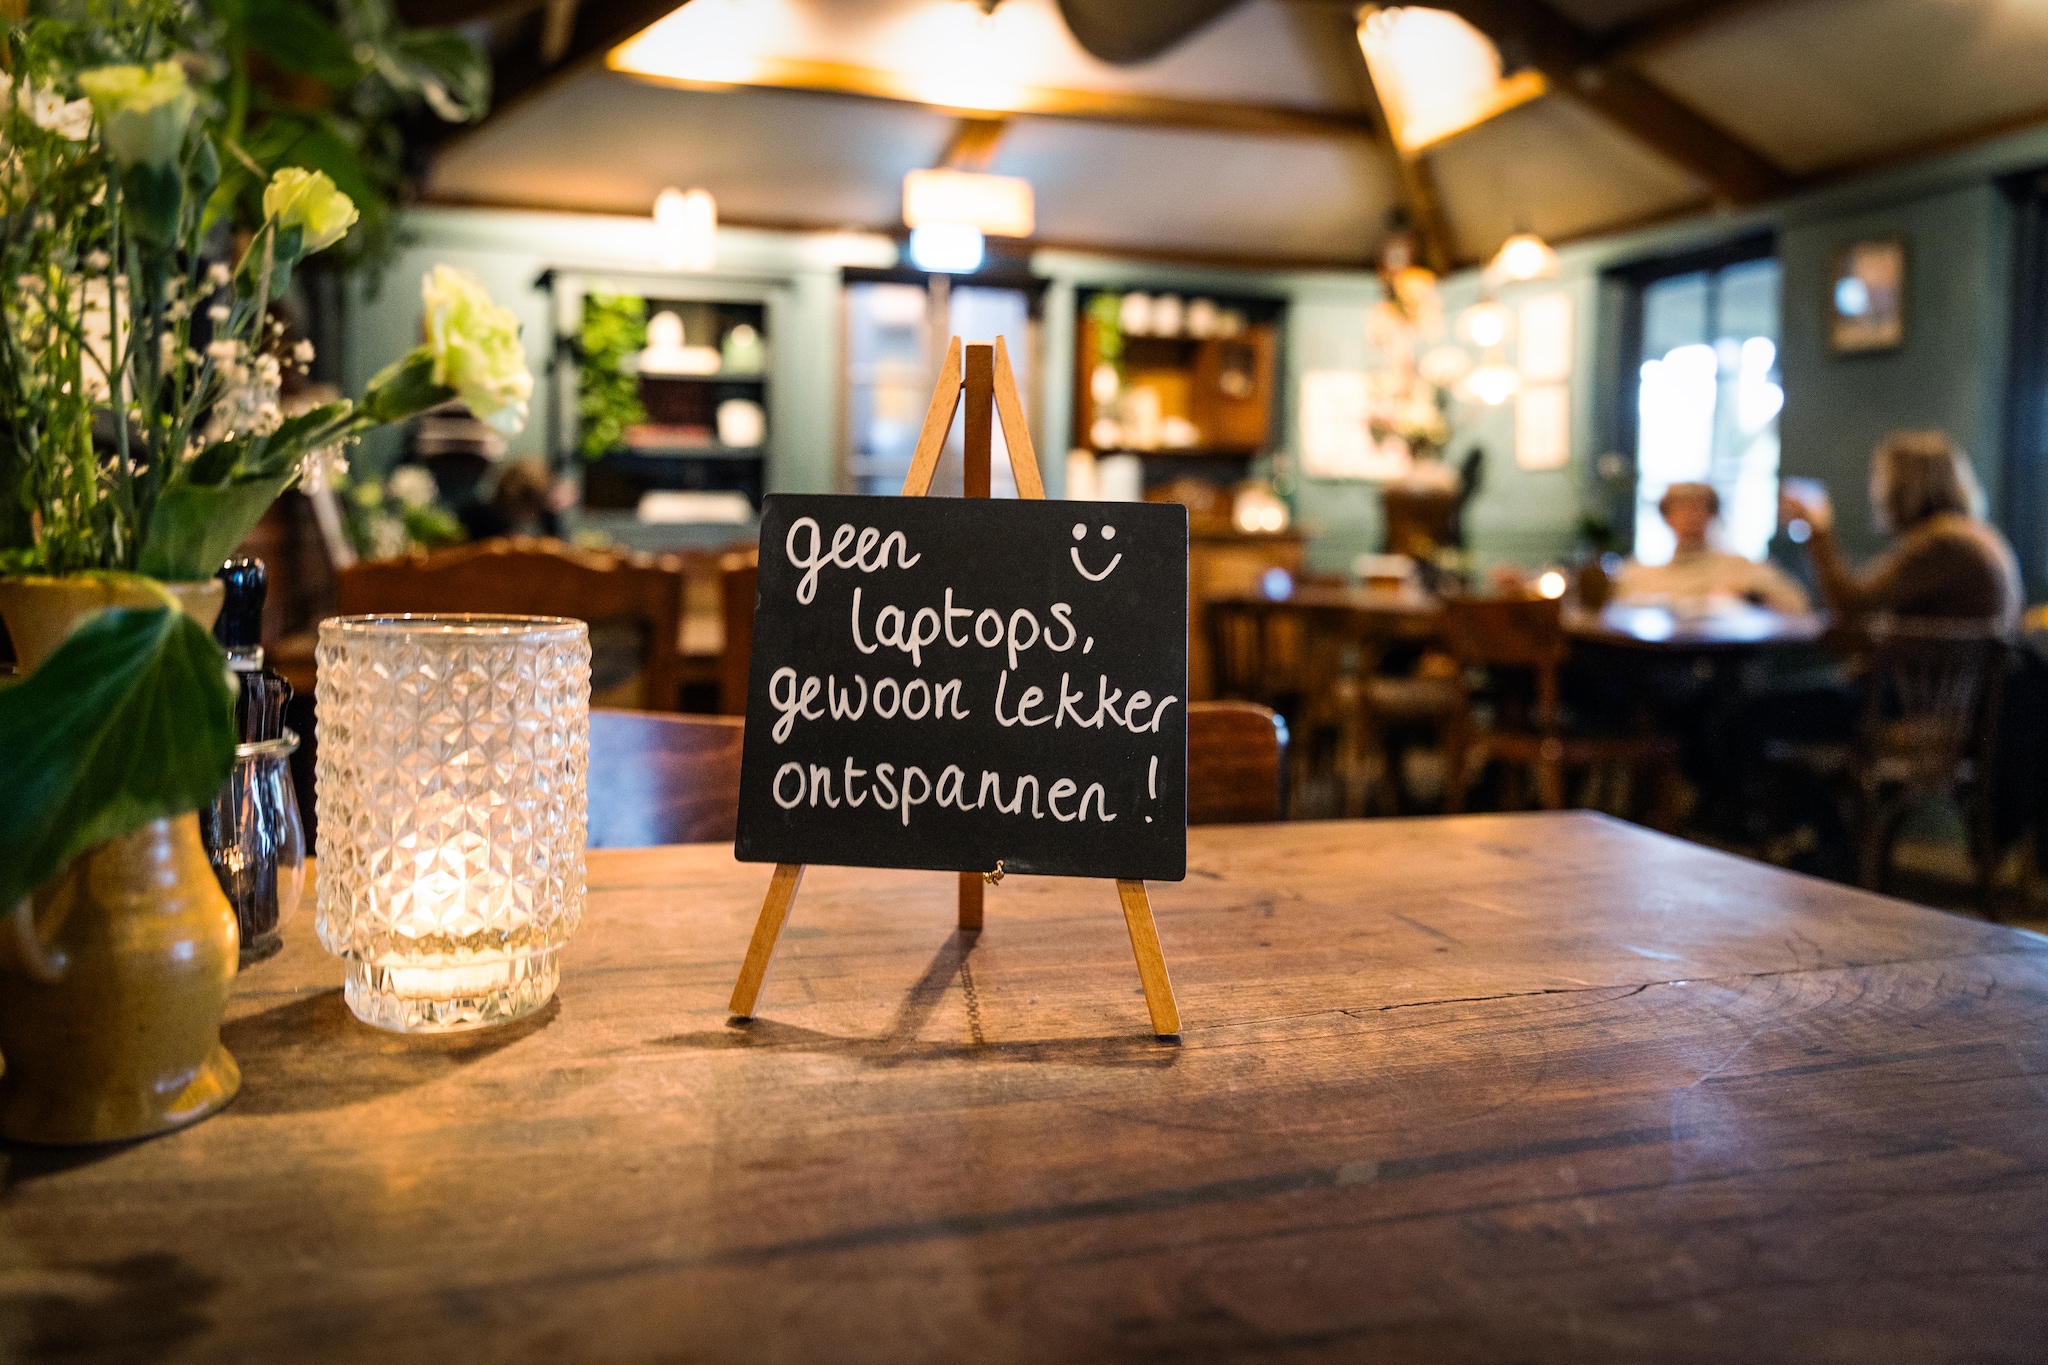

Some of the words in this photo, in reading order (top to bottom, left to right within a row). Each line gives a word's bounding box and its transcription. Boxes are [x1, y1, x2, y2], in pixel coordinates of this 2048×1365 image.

[785, 516, 922, 605] geen
[851, 587, 1095, 671] laptops,
[769, 666, 970, 744] gewoon
[994, 669, 1179, 734] lekker
[772, 756, 1118, 827] ontspannen
